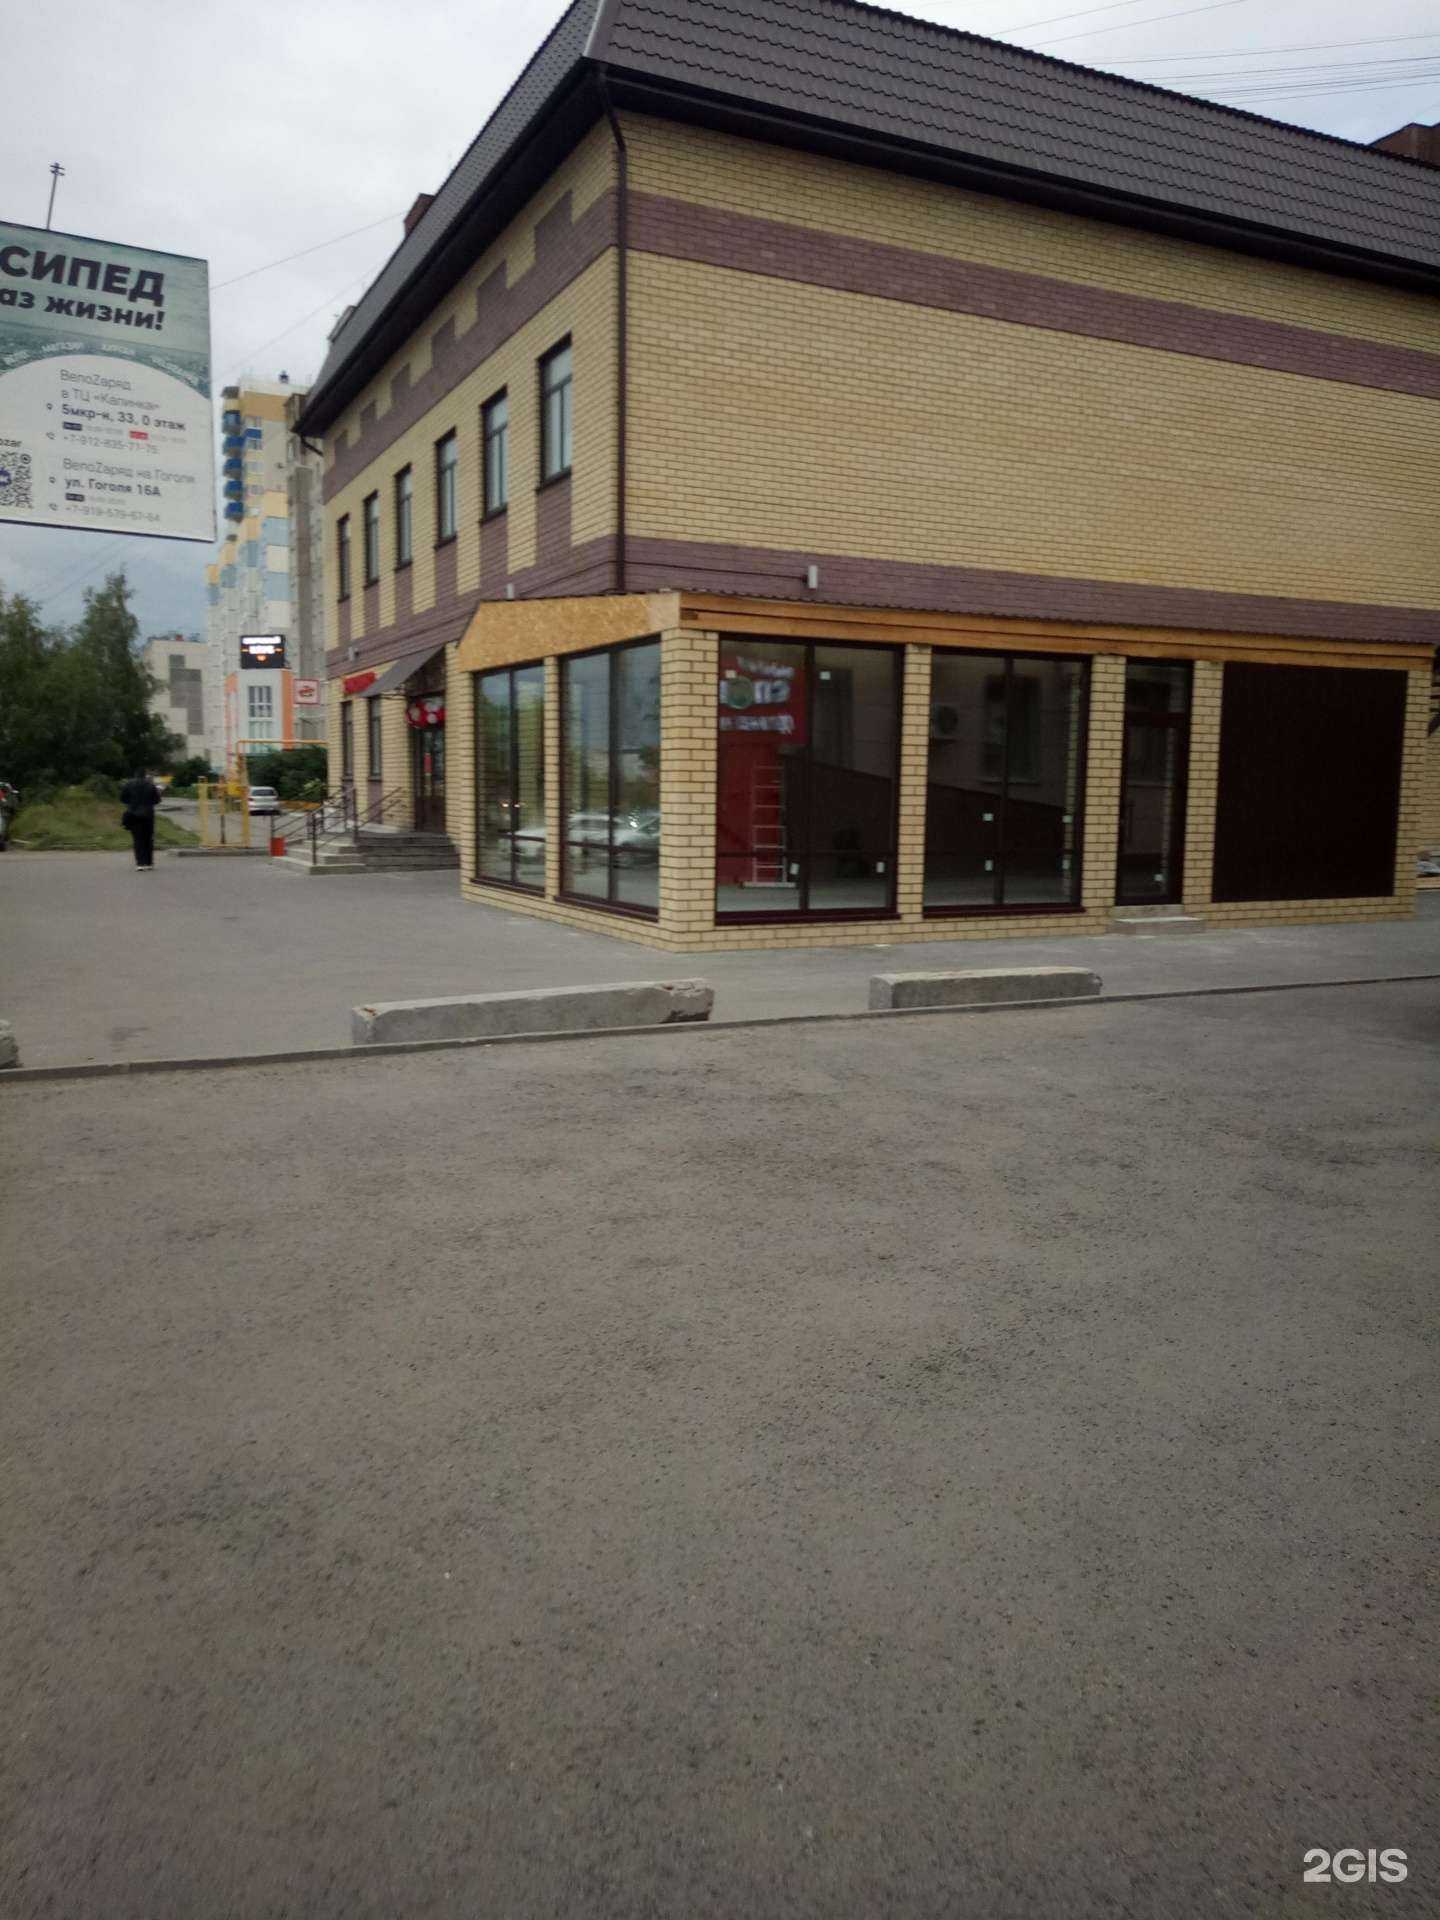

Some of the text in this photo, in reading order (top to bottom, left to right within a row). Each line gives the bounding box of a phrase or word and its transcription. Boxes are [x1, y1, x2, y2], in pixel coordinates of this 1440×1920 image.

[0, 245, 165, 307] СИПЕД
[0, 288, 166, 331] аз жизни!
[154, 419, 186, 431] этаж
